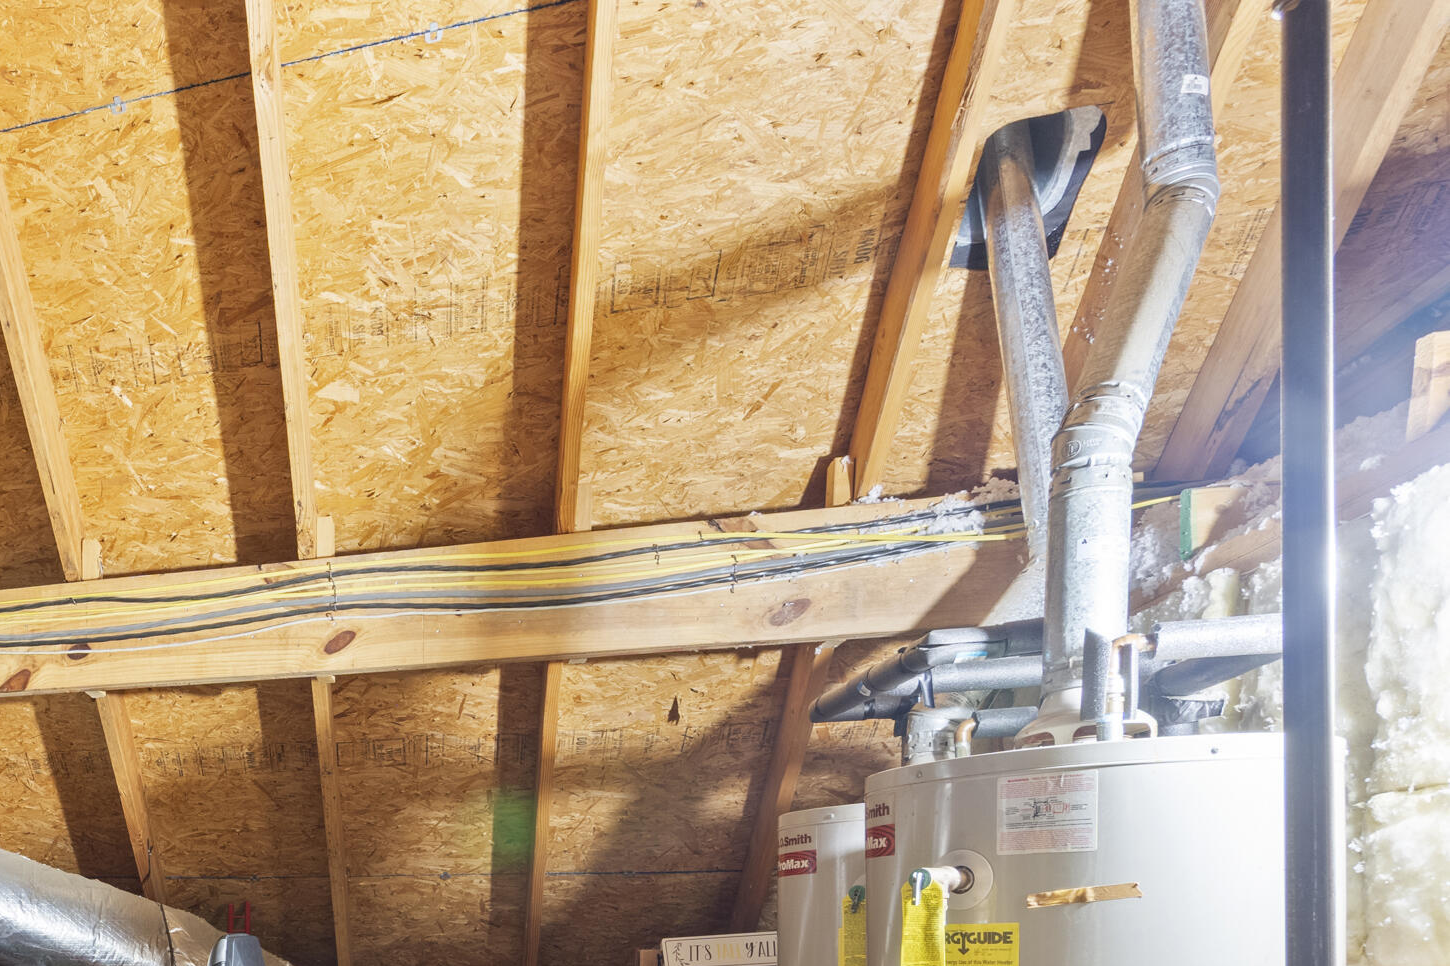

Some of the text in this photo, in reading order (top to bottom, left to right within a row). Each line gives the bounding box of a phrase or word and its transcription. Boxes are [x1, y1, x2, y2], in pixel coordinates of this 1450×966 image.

[867, 803, 890, 819] mith
[867, 836, 887, 849] Max
[689, 945, 712, 961] IT'S
